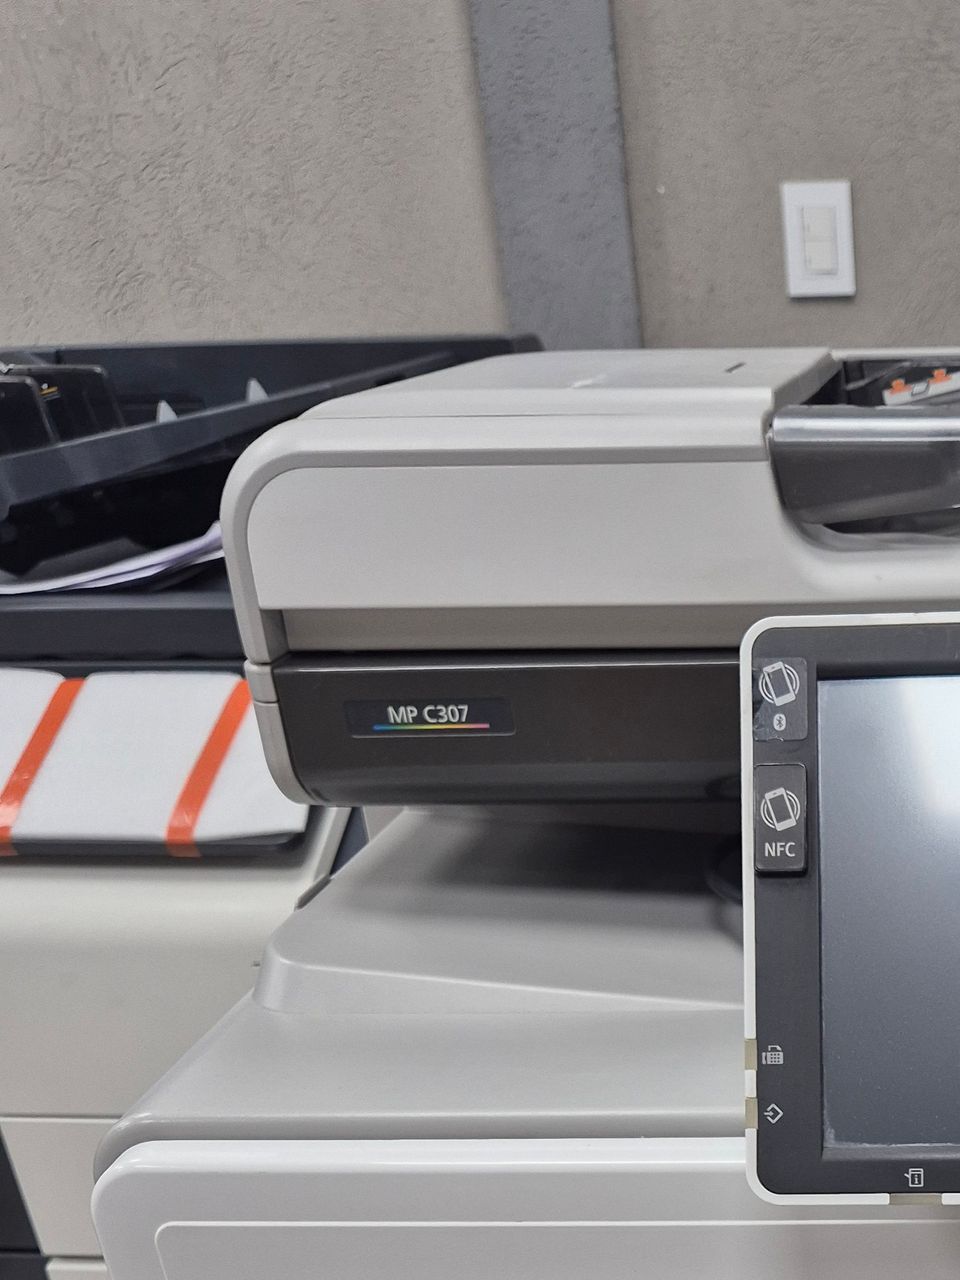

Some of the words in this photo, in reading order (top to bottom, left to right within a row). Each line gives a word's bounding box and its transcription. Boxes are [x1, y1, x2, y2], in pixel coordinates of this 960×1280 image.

[387, 705, 418, 723] MP
[423, 704, 468, 723] C307
[764, 841, 796, 857] NFC
